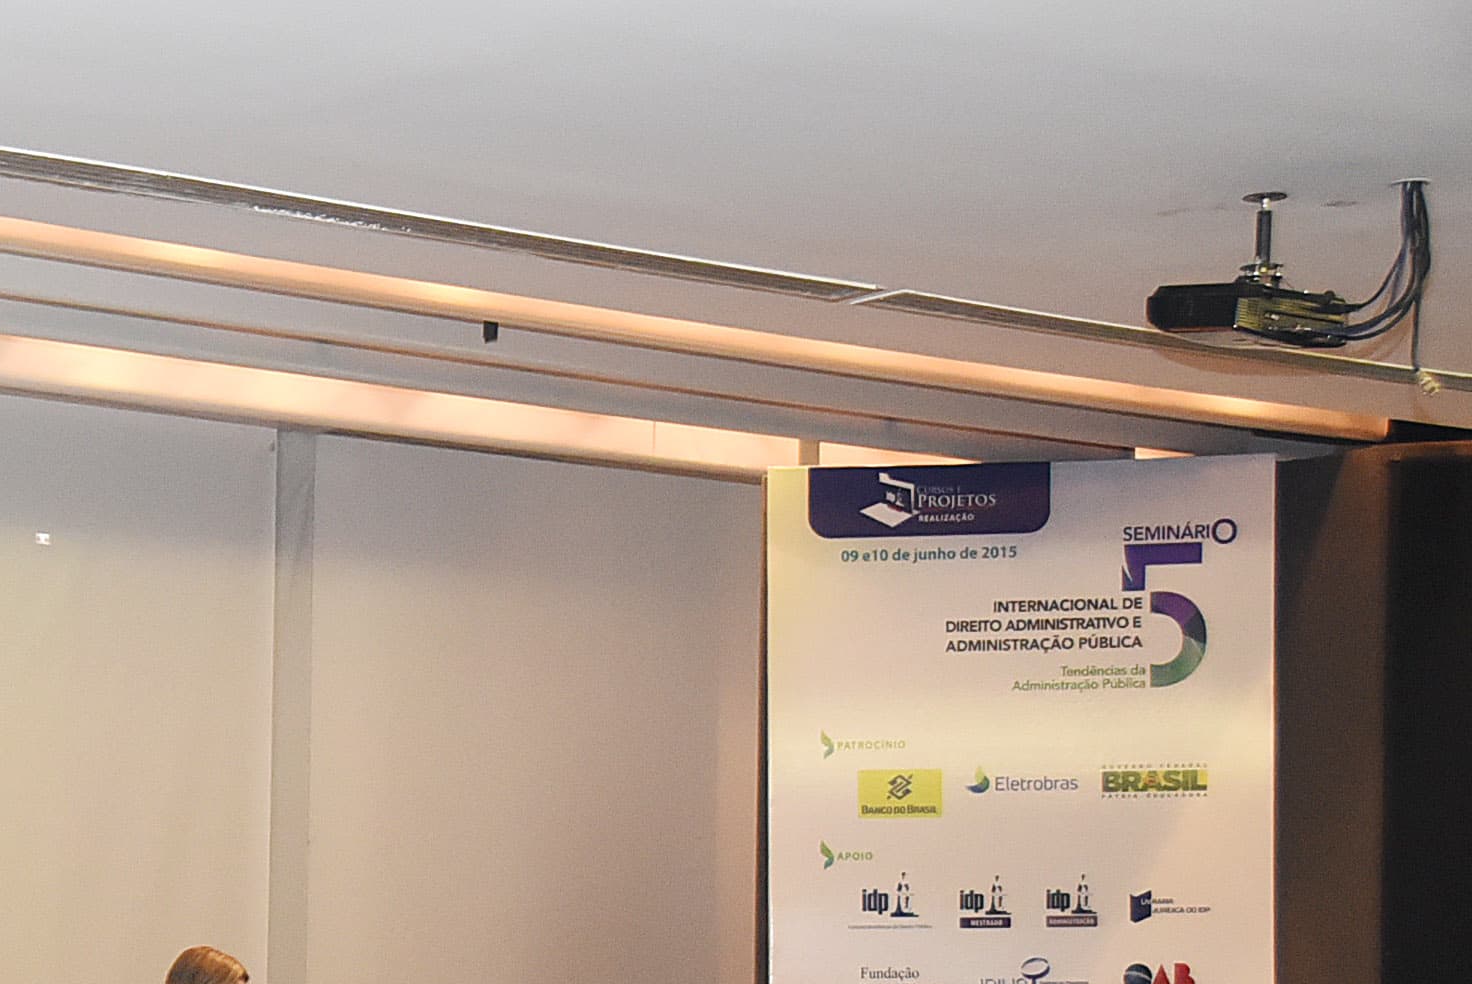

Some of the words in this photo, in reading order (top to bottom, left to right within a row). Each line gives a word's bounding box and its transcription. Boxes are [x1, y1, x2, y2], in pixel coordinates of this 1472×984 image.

[918, 493, 997, 508] PROJETOS
[841, 551, 858, 562] 09
[892, 548, 910, 561] de
[912, 547, 956, 563] junho
[960, 546, 977, 560] de
[982, 545, 1017, 559] 2015
[993, 598, 1118, 613] INTERNACIONAL
[1122, 596, 1143, 610] DE
[945, 619, 1002, 633] DIREITO
[1005, 617, 1130, 632] ADMINISTRATIVO
[1133, 616, 1142, 629] E
[945, 635, 1075, 654] ADMINISTRAÇÃO
[1078, 633, 1143, 650] PÚBLICA
[1061, 664, 1127, 678] Tendências
[1130, 663, 1146, 676] da
[1012, 678, 1098, 693] Administração
[1102, 675, 1146, 689] Pública
[995, 775, 1078, 792] Eletrobras
[1101, 770, 1208, 793] BRASIL
[837, 851, 873, 861] APOIO
[861, 888, 889, 915] idp
[959, 889, 984, 913] idp
[1046, 888, 1071, 912] idp
[860, 966, 920, 981] Fundação
